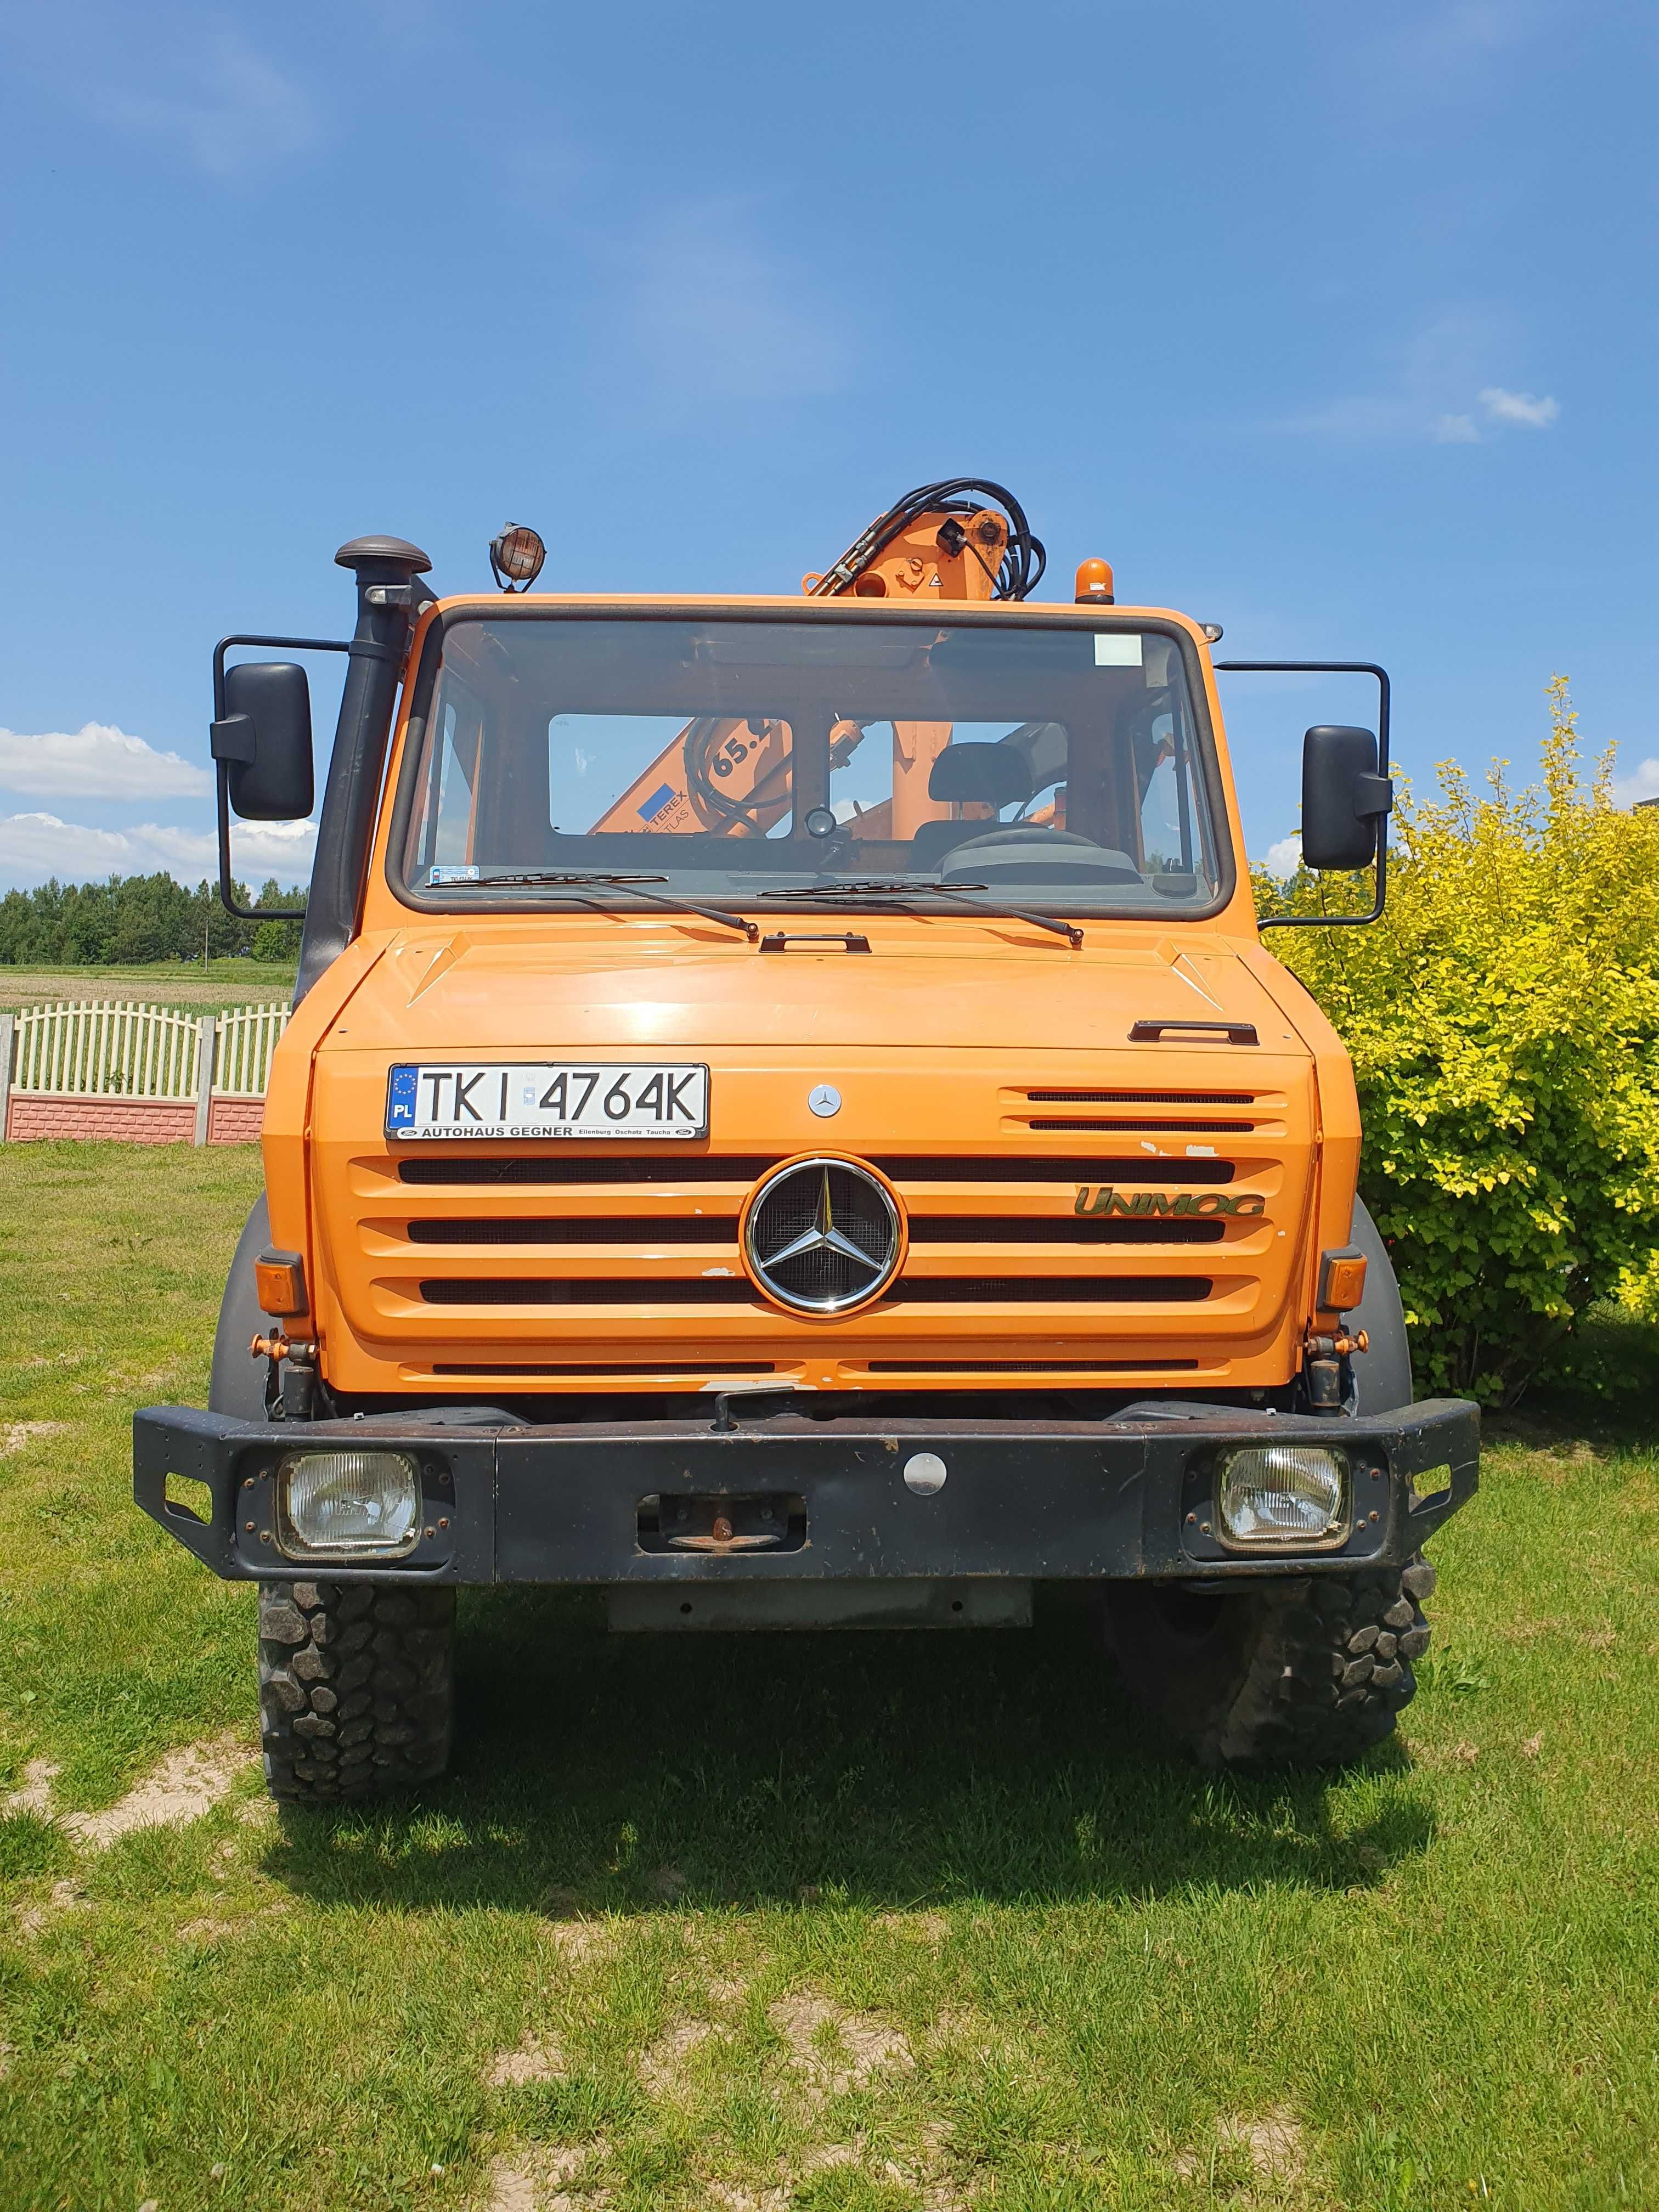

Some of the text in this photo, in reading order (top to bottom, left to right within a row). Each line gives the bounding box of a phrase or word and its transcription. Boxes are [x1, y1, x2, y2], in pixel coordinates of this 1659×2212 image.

[650, 790, 687, 826] TEREX
[663, 809, 689, 833] TLAS
[539, 1072, 697, 1120] 4764K
[394, 1104, 412, 1118] PL
[422, 1128, 505, 1137] AUTOHAUS
[510, 1127, 573, 1136] GEGNER
[1074, 1187, 1266, 1216] UNIMOG
